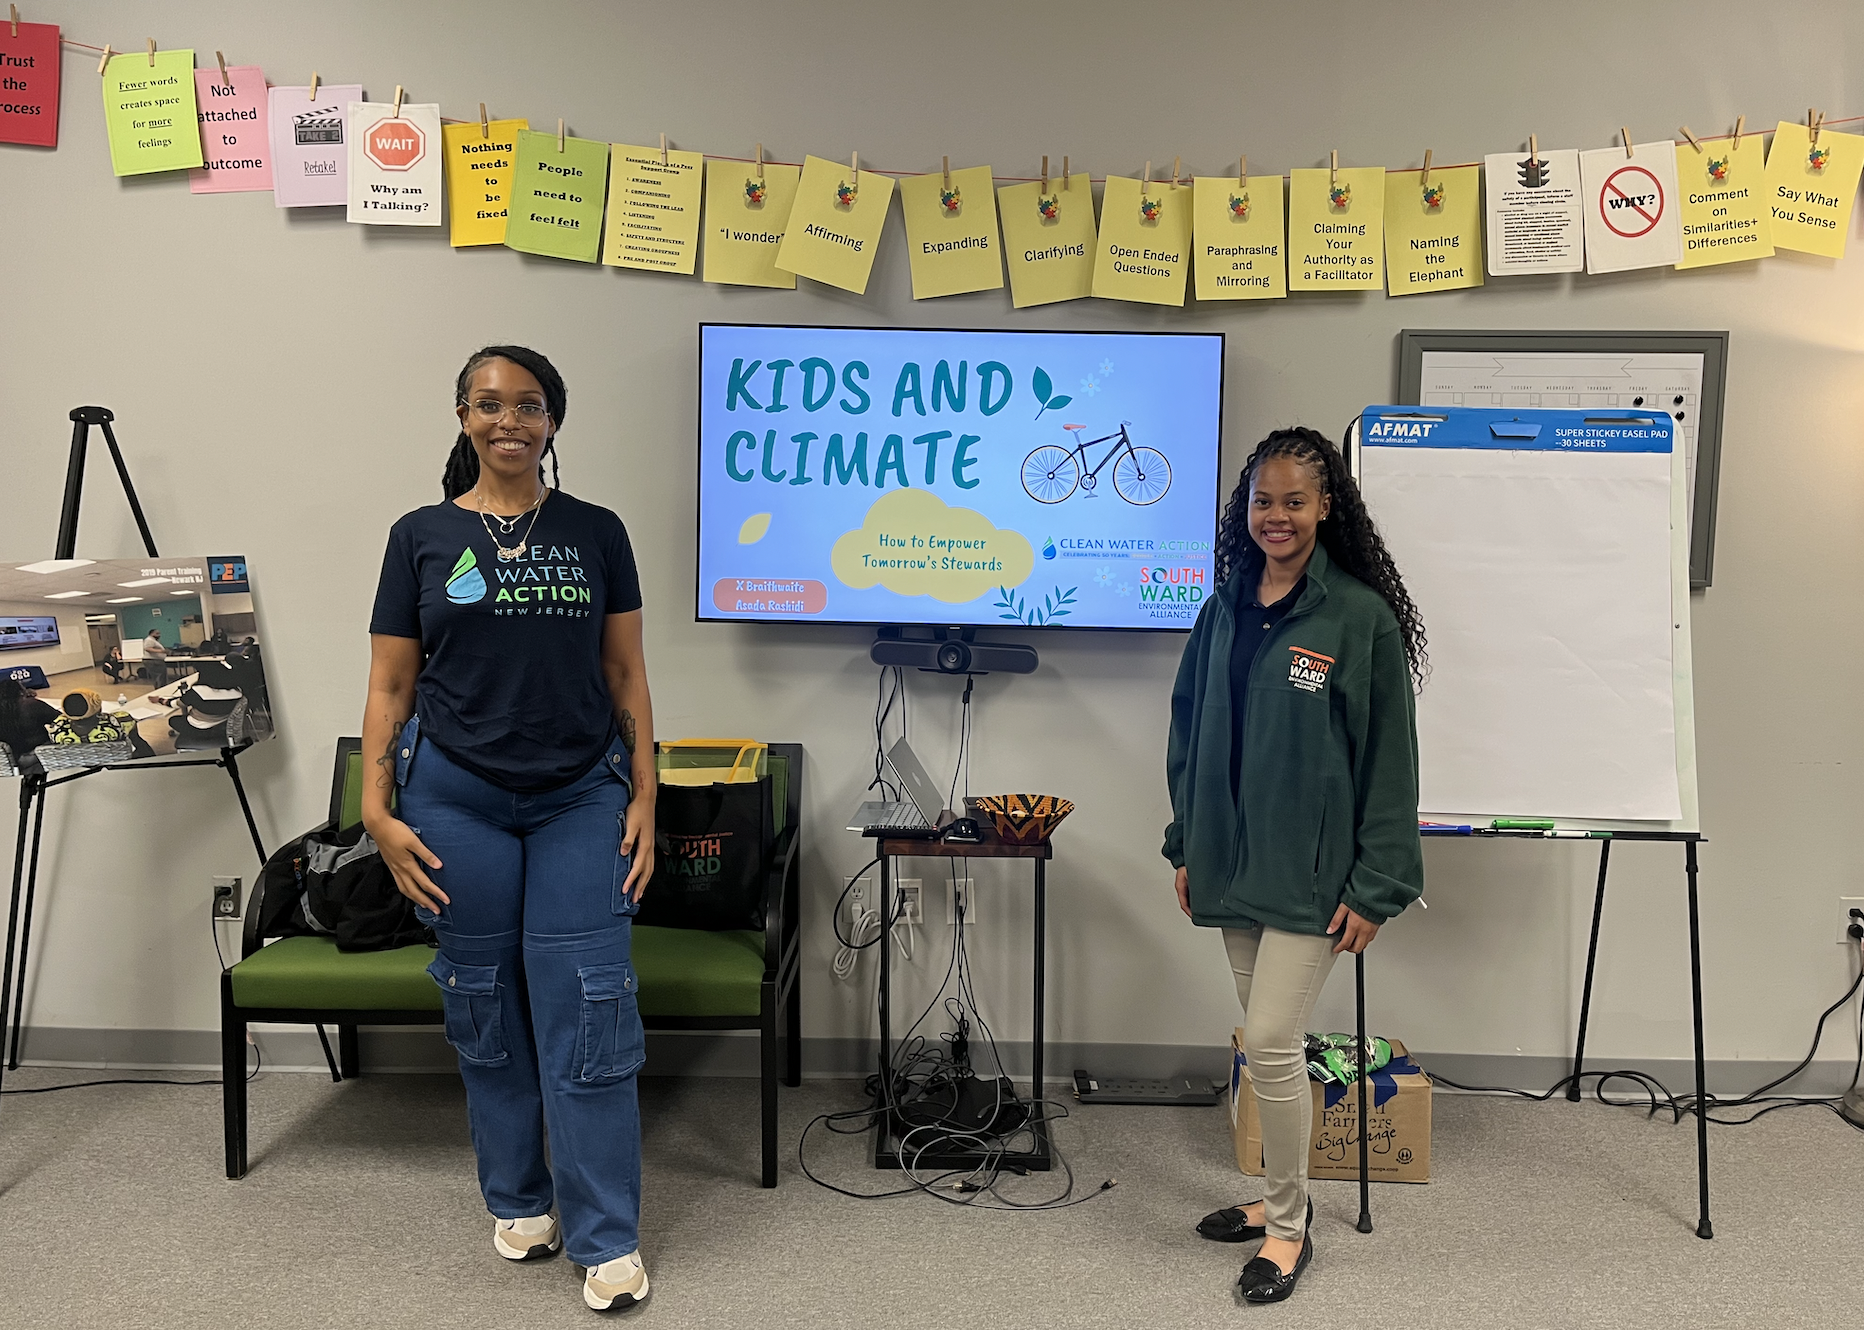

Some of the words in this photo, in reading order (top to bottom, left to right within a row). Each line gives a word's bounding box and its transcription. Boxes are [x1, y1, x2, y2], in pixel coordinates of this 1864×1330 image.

[0, 53, 35, 67] Trust
[3, 77, 27, 90] the
[119, 81, 148, 92] Fewer
[150, 77, 178, 87] words
[211, 85, 236, 97] Not
[0, 103, 41, 115] ocess
[121, 100, 152, 110] creates
[155, 97, 180, 107] space
[198, 107, 257, 122] attached
[133, 120, 146, 129] for
[149, 118, 173, 129] more
[222, 135, 237, 145] to
[299, 131, 327, 141] TAKE
[331, 131, 339, 141] 2
[138, 138, 172, 149] feelings
[376, 137, 415, 151] WAIT
[462, 142, 513, 155] Nothing
[203, 159, 263, 170] outcome
[471, 159, 509, 170] needs
[539, 163, 583, 178] People
[485, 177, 498, 186] to
[371, 185, 399, 196] Why
[402, 187, 423, 195] am
[534, 188, 566, 201] need
[569, 194, 582, 203] to
[1689, 188, 1749, 204] Comment
[1777, 187, 1801, 203] Say
[1806, 191, 1839, 208] What
[486, 194, 501, 202] be
[1609, 194, 1656, 210] WHY?
[363, 201, 369, 209] I
[372, 201, 429, 213] Talking?
[1713, 207, 1728, 217] on
[477, 209, 508, 220] fixed
[530, 213, 555, 225] feel
[557, 217, 580, 230] felt
[1771, 207, 1794, 222] You
[1798, 213, 1837, 230] Sense
[1314, 223, 1366, 236] Claiming
[1684, 218, 1759, 235] Similarities+
[804, 223, 864, 252] Affirming
[1326, 239, 1353, 249] Your
[1410, 236, 1460, 250] Naming
[1688, 233, 1758, 250] Differences
[923, 236, 989, 254] Expanding
[1207, 245, 1278, 257] Paraphrasing
[1025, 243, 1085, 262] Clarifying
[1110, 244, 1139, 259] Open
[1143, 249, 1179, 263] Ended
[1426, 254, 1445, 265] the
[1232, 260, 1253, 270] and
[1304, 255, 1357, 266] Authority
[1360, 257, 1374, 265] as
[1113, 261, 1171, 278] Questions
[1304, 272, 1311, 280] a
[1315, 270, 1374, 280] Facilitator
[1410, 267, 1464, 282] Elephant
[1216, 276, 1270, 287] Mirroring
[726, 357, 872, 415] KIDS
[892, 359, 1014, 417] AND
[1369, 422, 1433, 437] AFMAT
[1556, 429, 1584, 437] SUPER
[1586, 429, 1621, 438] STICKEY
[1623, 430, 1649, 438] EASEL
[1651, 431, 1669, 439] PAD
[1574, 440, 1607, 448] SHEETS
[725, 430, 982, 489] CLIMATE
[880, 534, 907, 548] How
[911, 535, 925, 548] to
[929, 535, 987, 553] Empower
[1061, 539, 1104, 550] CLEAN
[1108, 540, 1154, 550] WATER
[1159, 541, 1210, 551] ACTION
[862, 554, 937, 570] Tomorrow’s
[941, 557, 1003, 572] Stewards
[157, 568, 177, 576] Parent
[178, 567, 202, 576] Training
[212, 564, 247, 581] PEP
[495, 566, 588, 584] WATER
[1140, 567, 1205, 584] SOUTH
[172, 576, 195, 584] Newark
[736, 580, 744, 592] X
[746, 581, 805, 593] Braithwaite
[495, 586, 591, 604] ACTION
[1140, 585, 1203, 602] WARD
[495, 608, 529, 616] NEW
[536, 607, 590, 618] JERSEY
[736, 600, 766, 612] Asada
[768, 600, 804, 612] Rashidi
[1150, 611, 1192, 619] ALLIANCE
[1292, 655, 1329, 674] SOUTH
[1291, 665, 1326, 683] WARD
[663, 839, 721, 859] UTH
[665, 857, 722, 876] WARD
[1346, 1128, 1397, 1154] Cange
